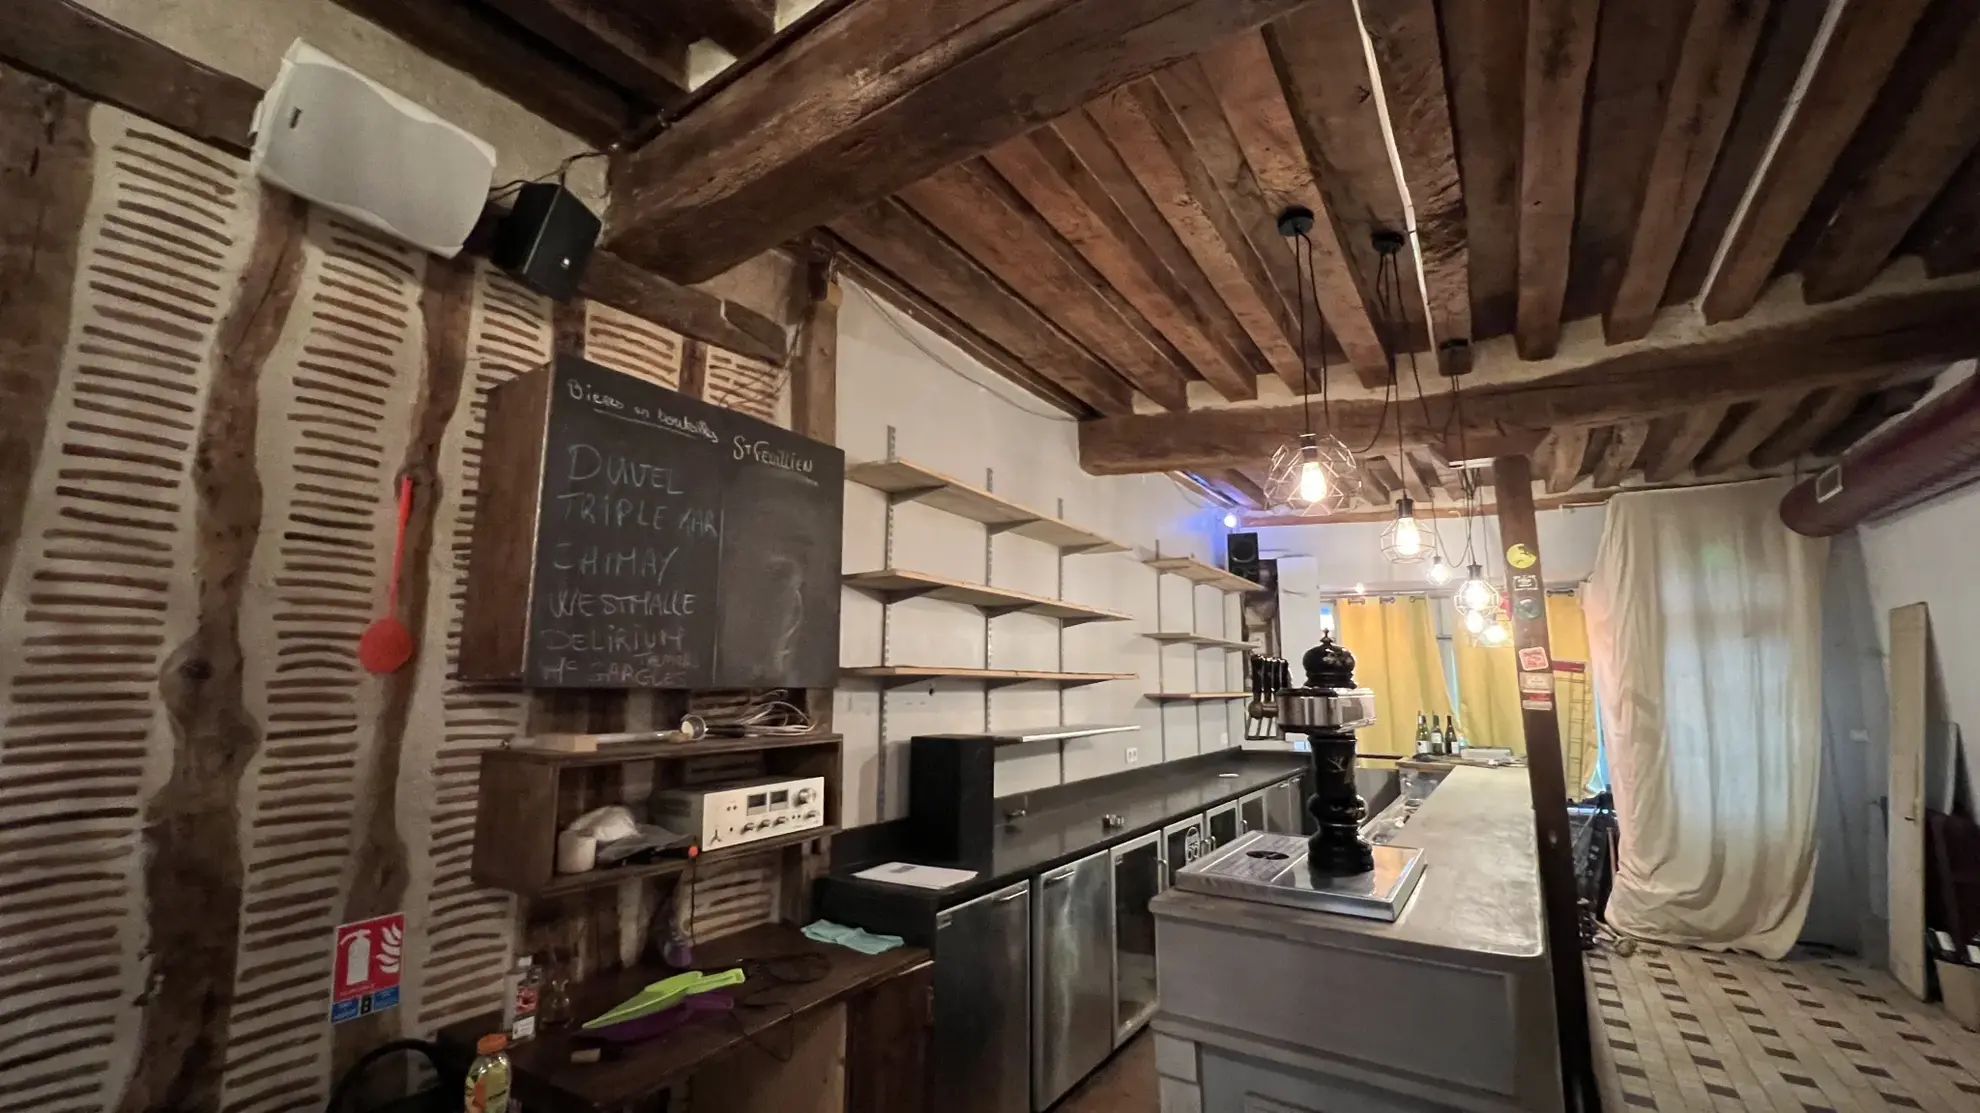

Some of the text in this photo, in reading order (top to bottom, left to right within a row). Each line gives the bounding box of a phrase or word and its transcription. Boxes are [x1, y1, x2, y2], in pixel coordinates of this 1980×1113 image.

[567, 444, 684, 494] DUVEL
[554, 543, 679, 585] CHIMAY
[550, 589, 696, 618] WESTMALLE
